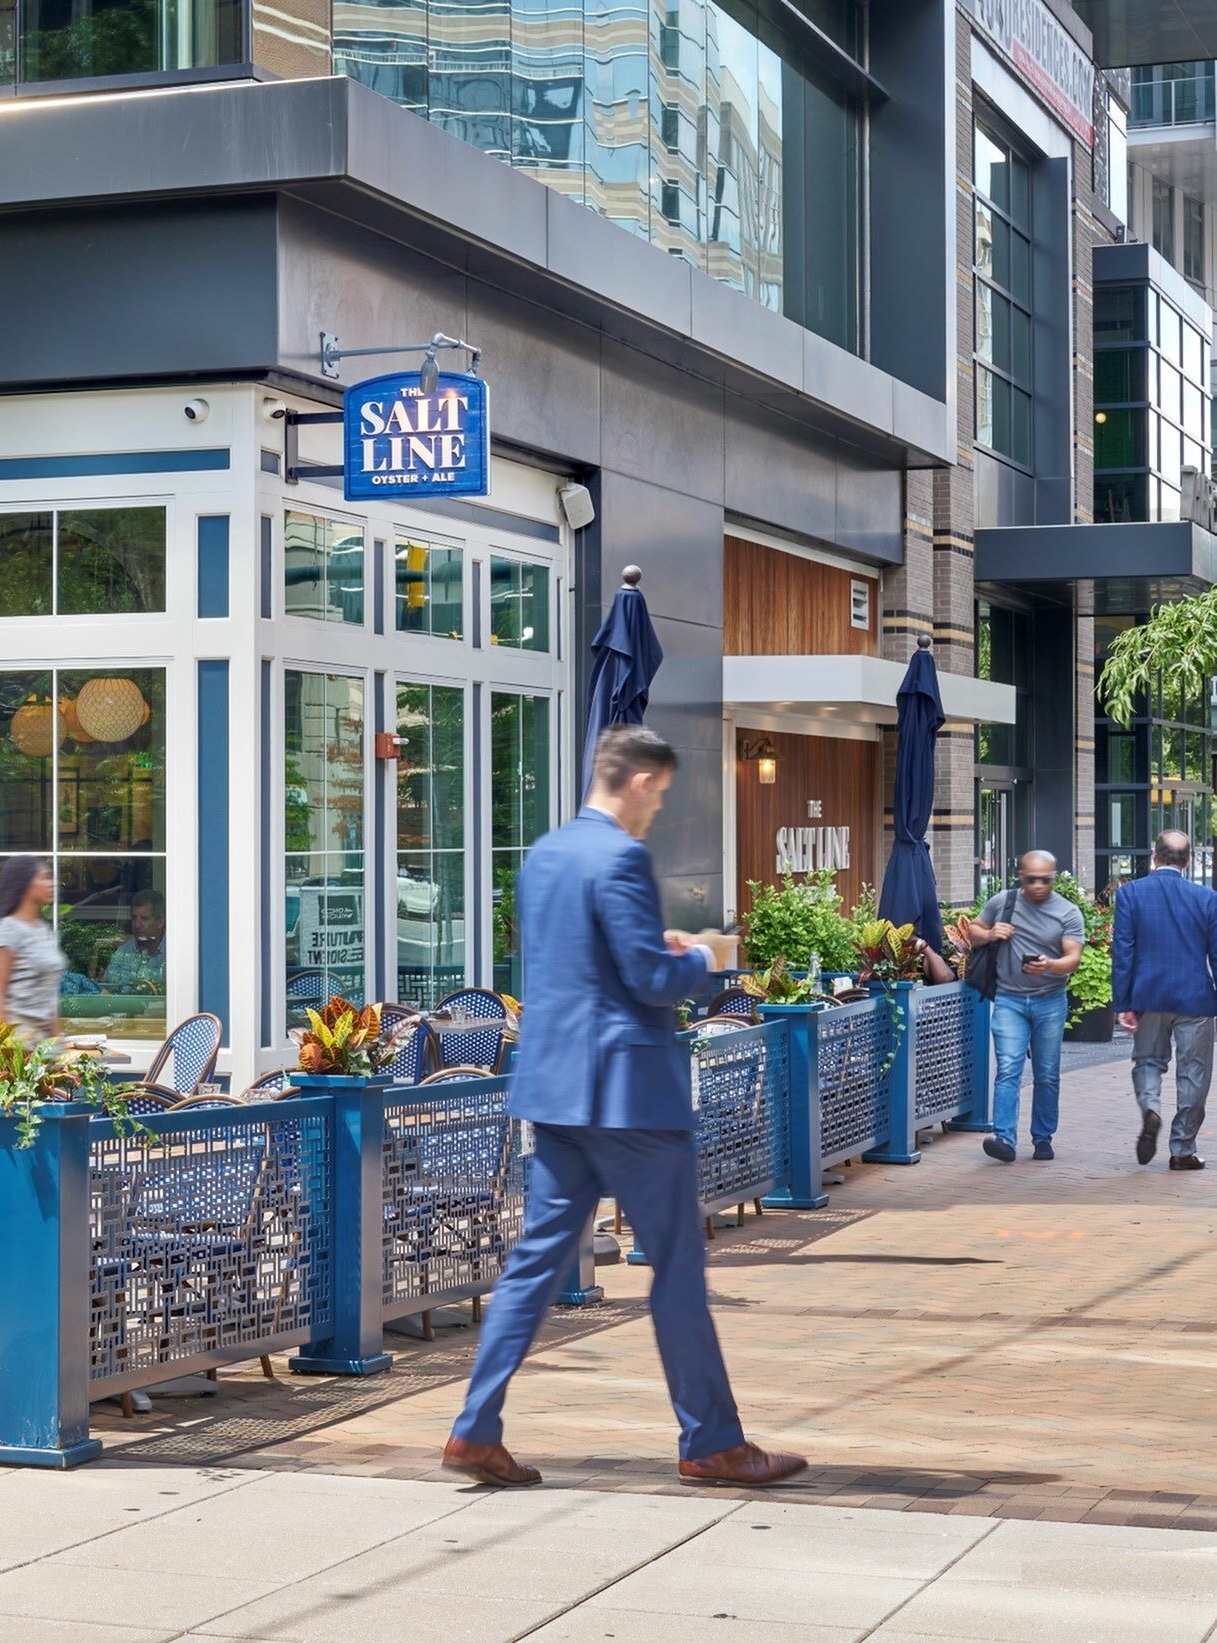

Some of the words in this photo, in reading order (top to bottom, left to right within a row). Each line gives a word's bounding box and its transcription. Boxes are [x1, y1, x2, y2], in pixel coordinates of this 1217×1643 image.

[360, 397, 468, 435] SALT
[360, 434, 466, 472] LINE
[371, 474, 418, 485] OYSTER
[431, 472, 455, 482] ALE
[807, 800, 822, 818] THE
[776, 826, 816, 874] SALT
[816, 826, 850, 871] LINE
